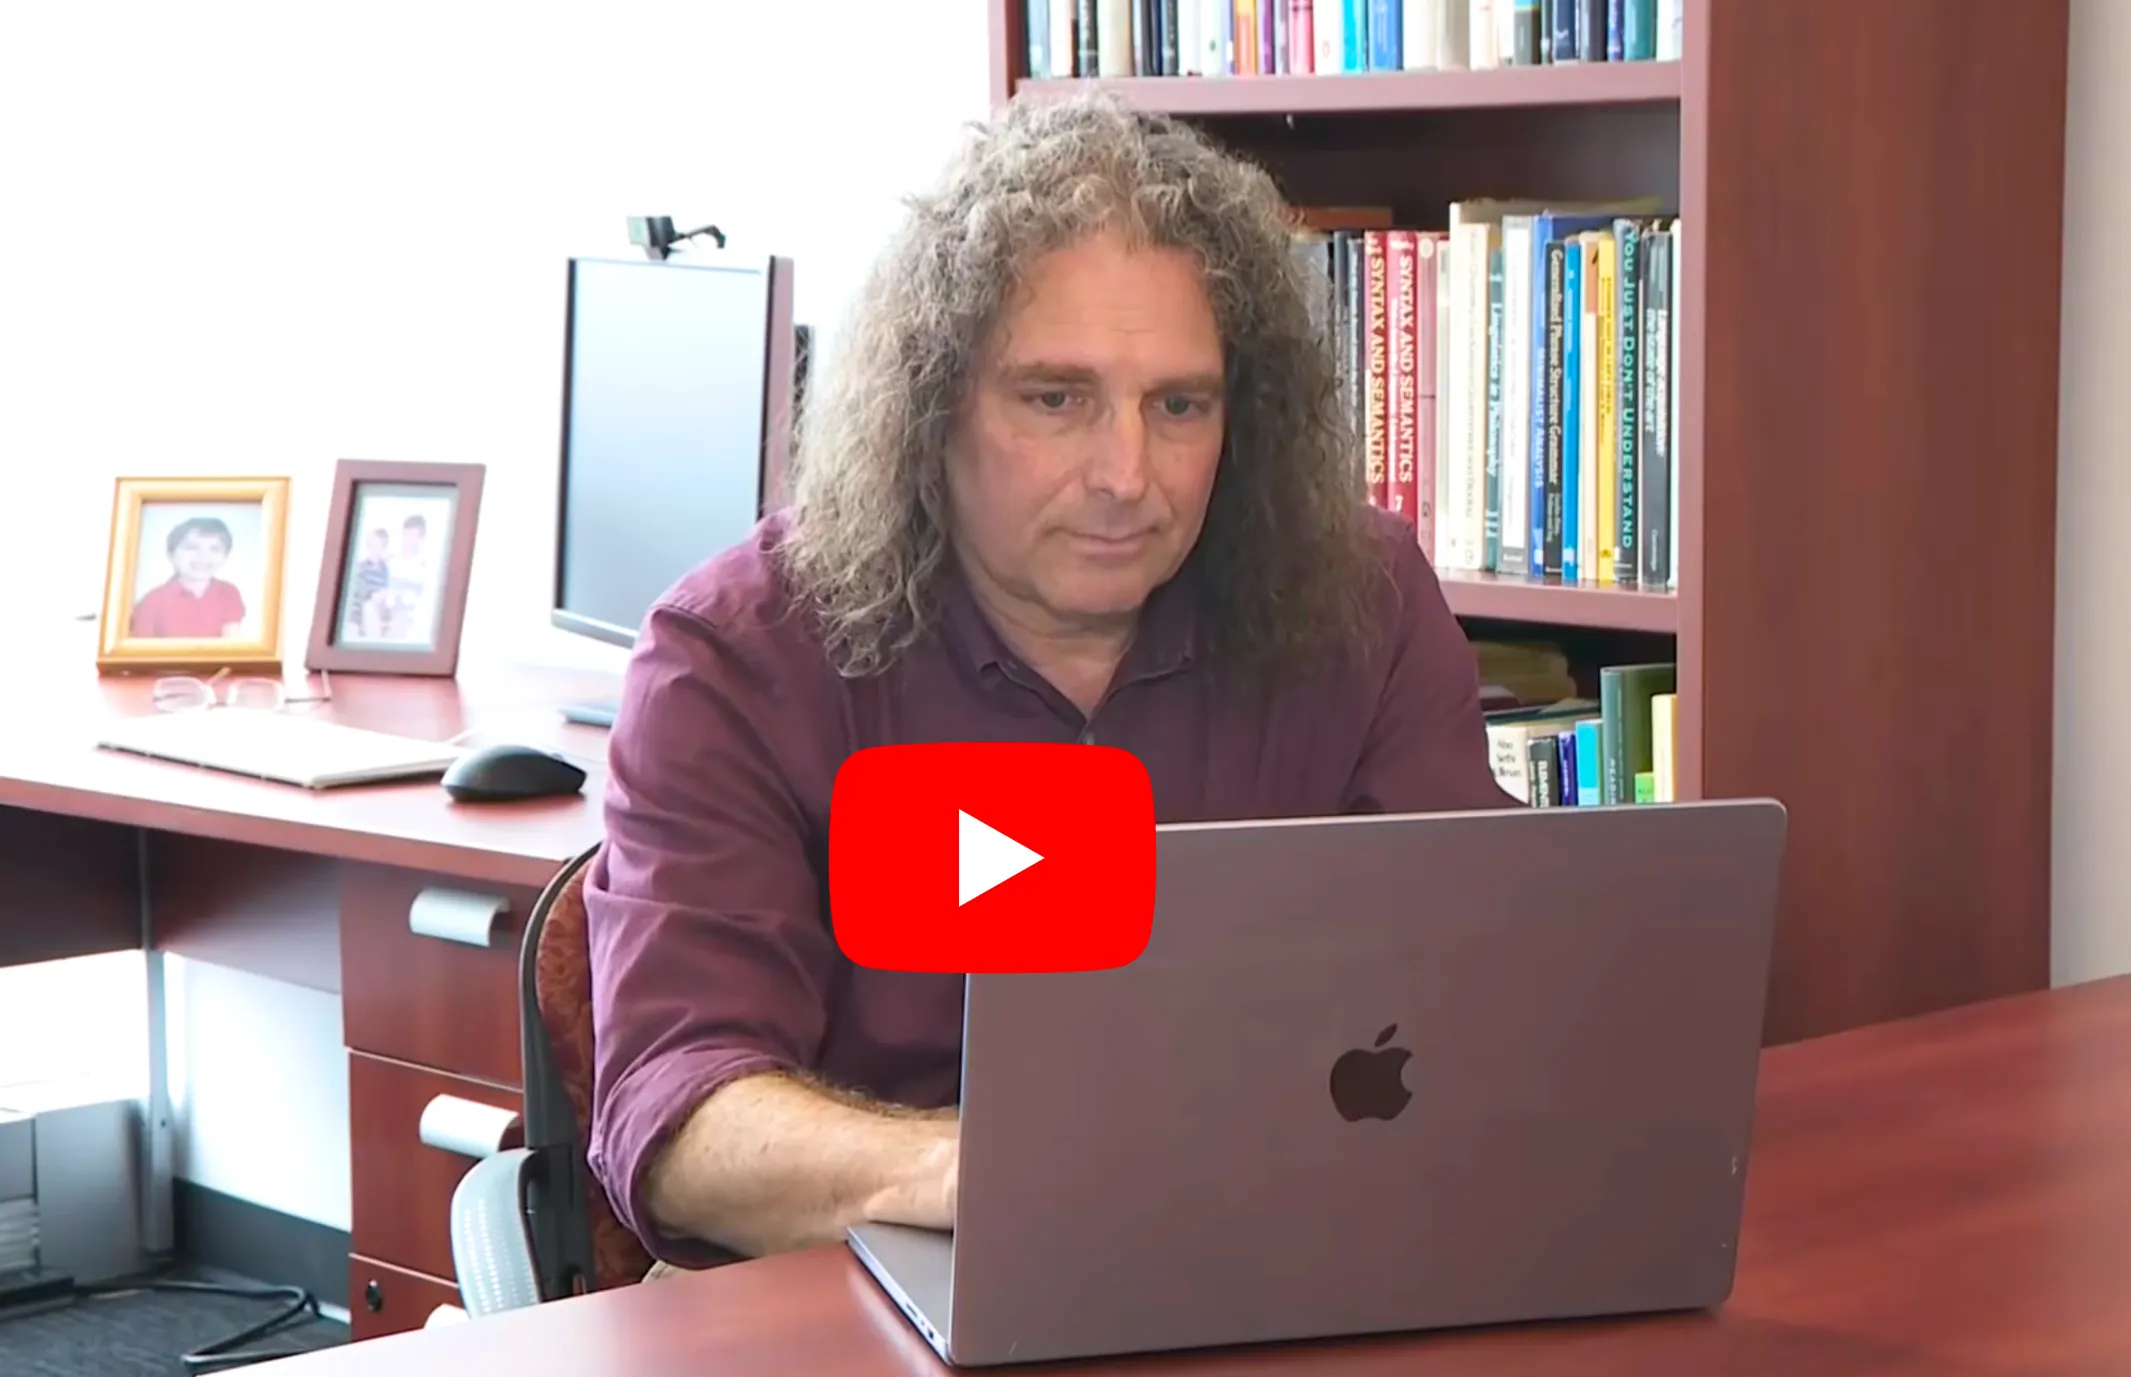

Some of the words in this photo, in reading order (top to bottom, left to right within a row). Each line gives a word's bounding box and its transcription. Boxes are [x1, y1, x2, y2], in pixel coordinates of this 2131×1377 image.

[1623, 230, 1637, 272] YOU
[1371, 257, 1386, 330] SYNTAX
[1400, 255, 1415, 326] SYNTAX
[1623, 277, 1636, 330] JUST
[1371, 334, 1385, 373] AND
[1400, 332, 1414, 372] AND
[1622, 337, 1636, 401] DON'T
[1370, 377, 1385, 484] SEMANTICS
[1399, 376, 1414, 483] SEMANTICS
[1622, 408, 1635, 548] UNDERSTAND
